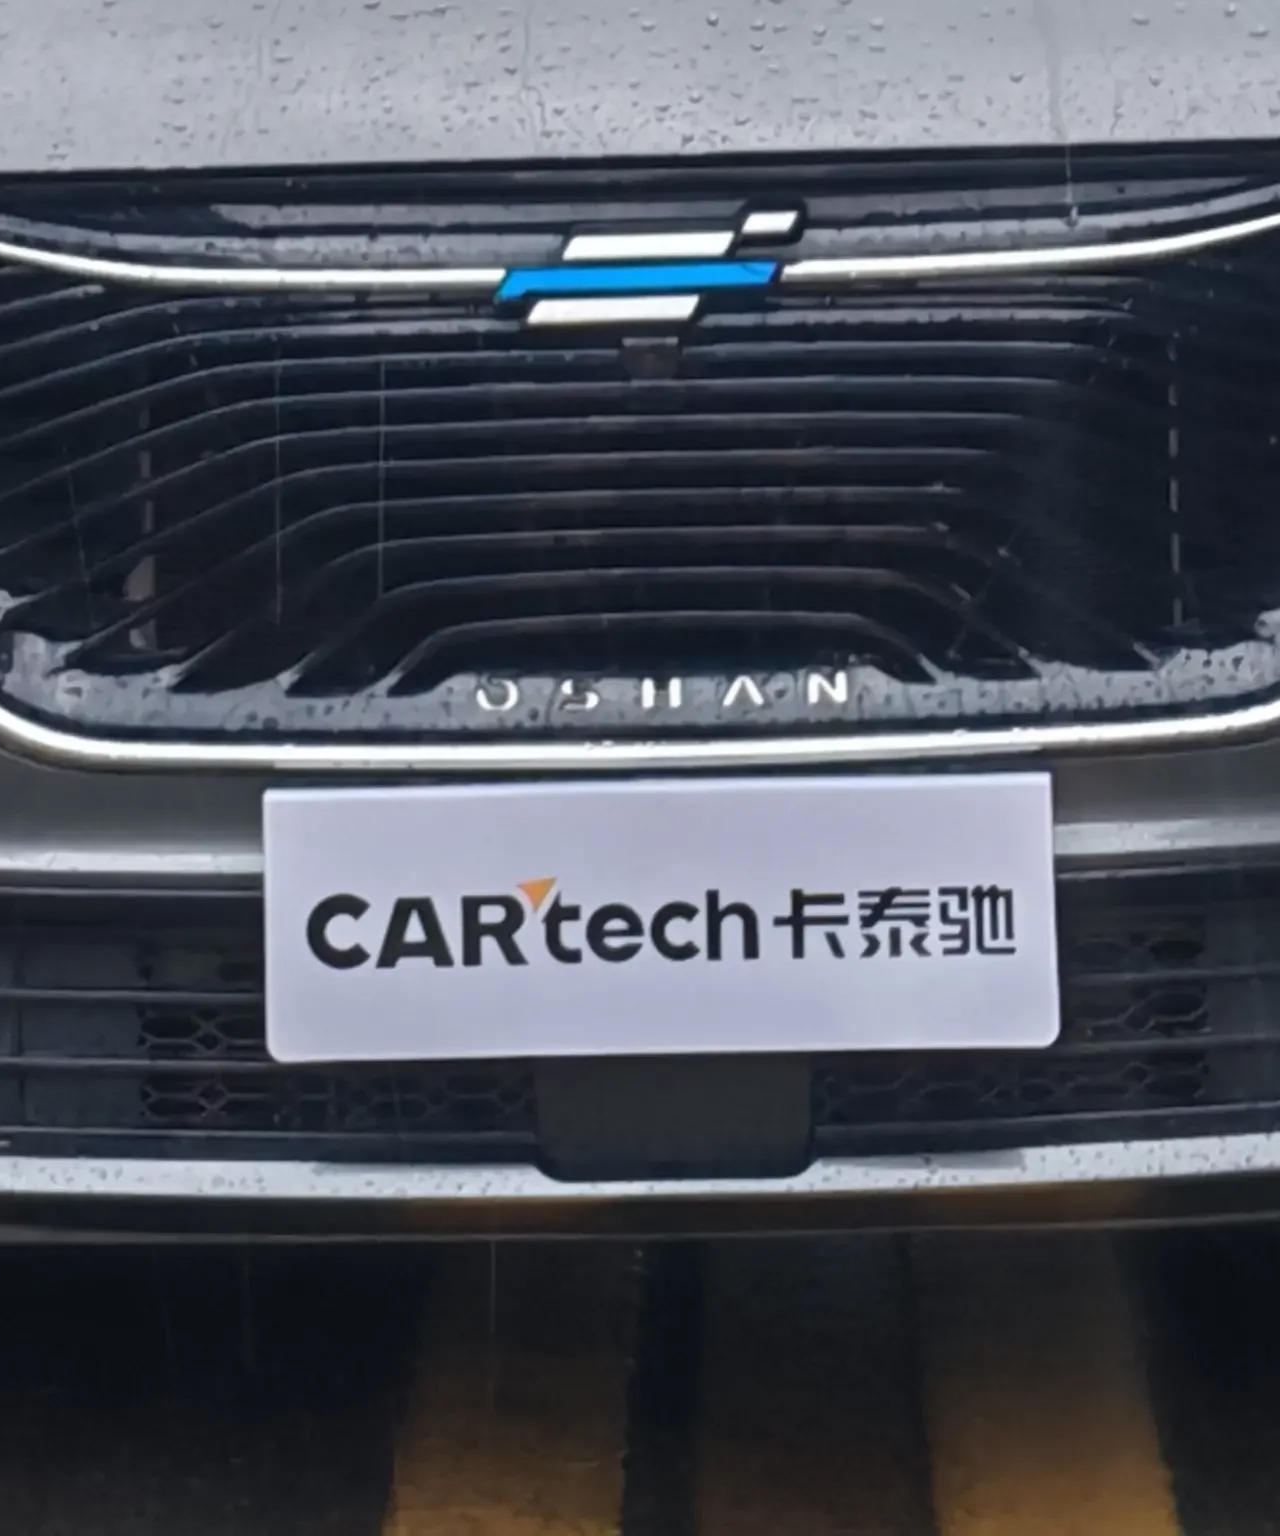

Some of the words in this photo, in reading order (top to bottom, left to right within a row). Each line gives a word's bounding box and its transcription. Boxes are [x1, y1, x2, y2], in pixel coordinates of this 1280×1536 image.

[476, 670, 849, 711] OSHAN
[306, 886, 760, 970] CARtech
[773, 884, 1017, 959] 卡泰驰
